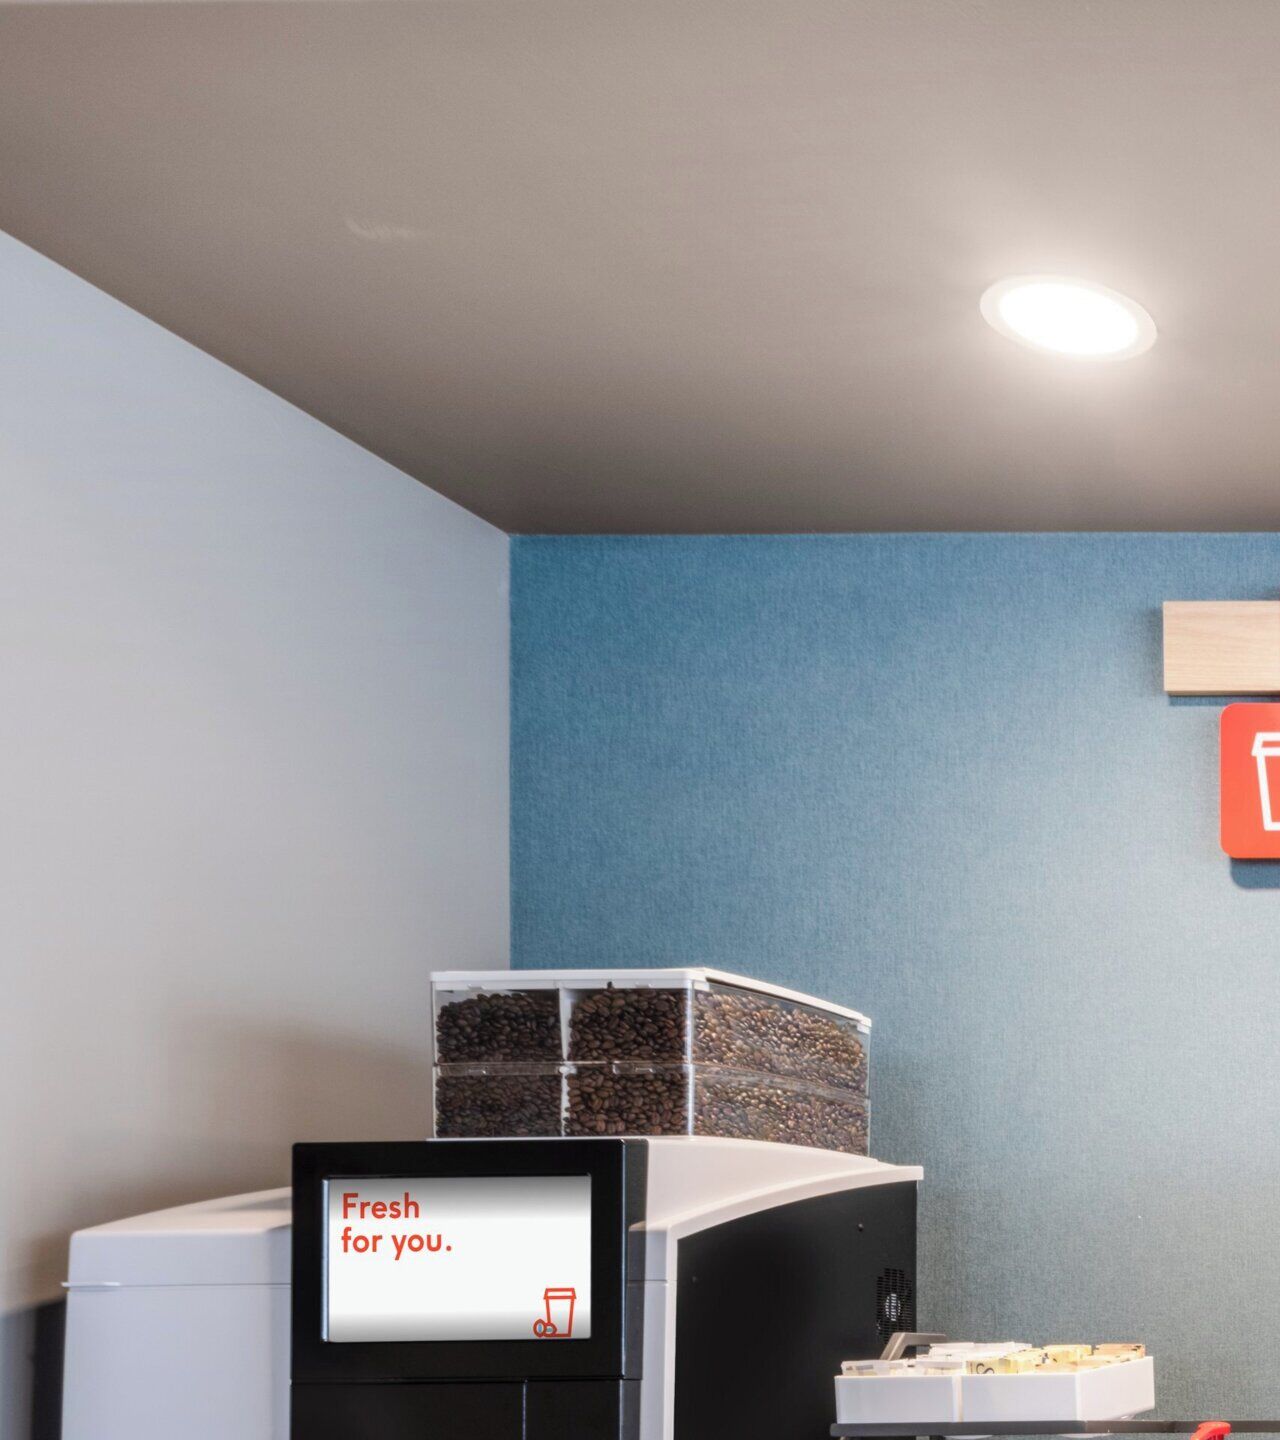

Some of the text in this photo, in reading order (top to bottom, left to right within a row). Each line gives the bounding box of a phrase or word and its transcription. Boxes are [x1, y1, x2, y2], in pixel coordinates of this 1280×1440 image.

[341, 1192, 420, 1220] Fresh
[341, 1226, 453, 1261] for you.
